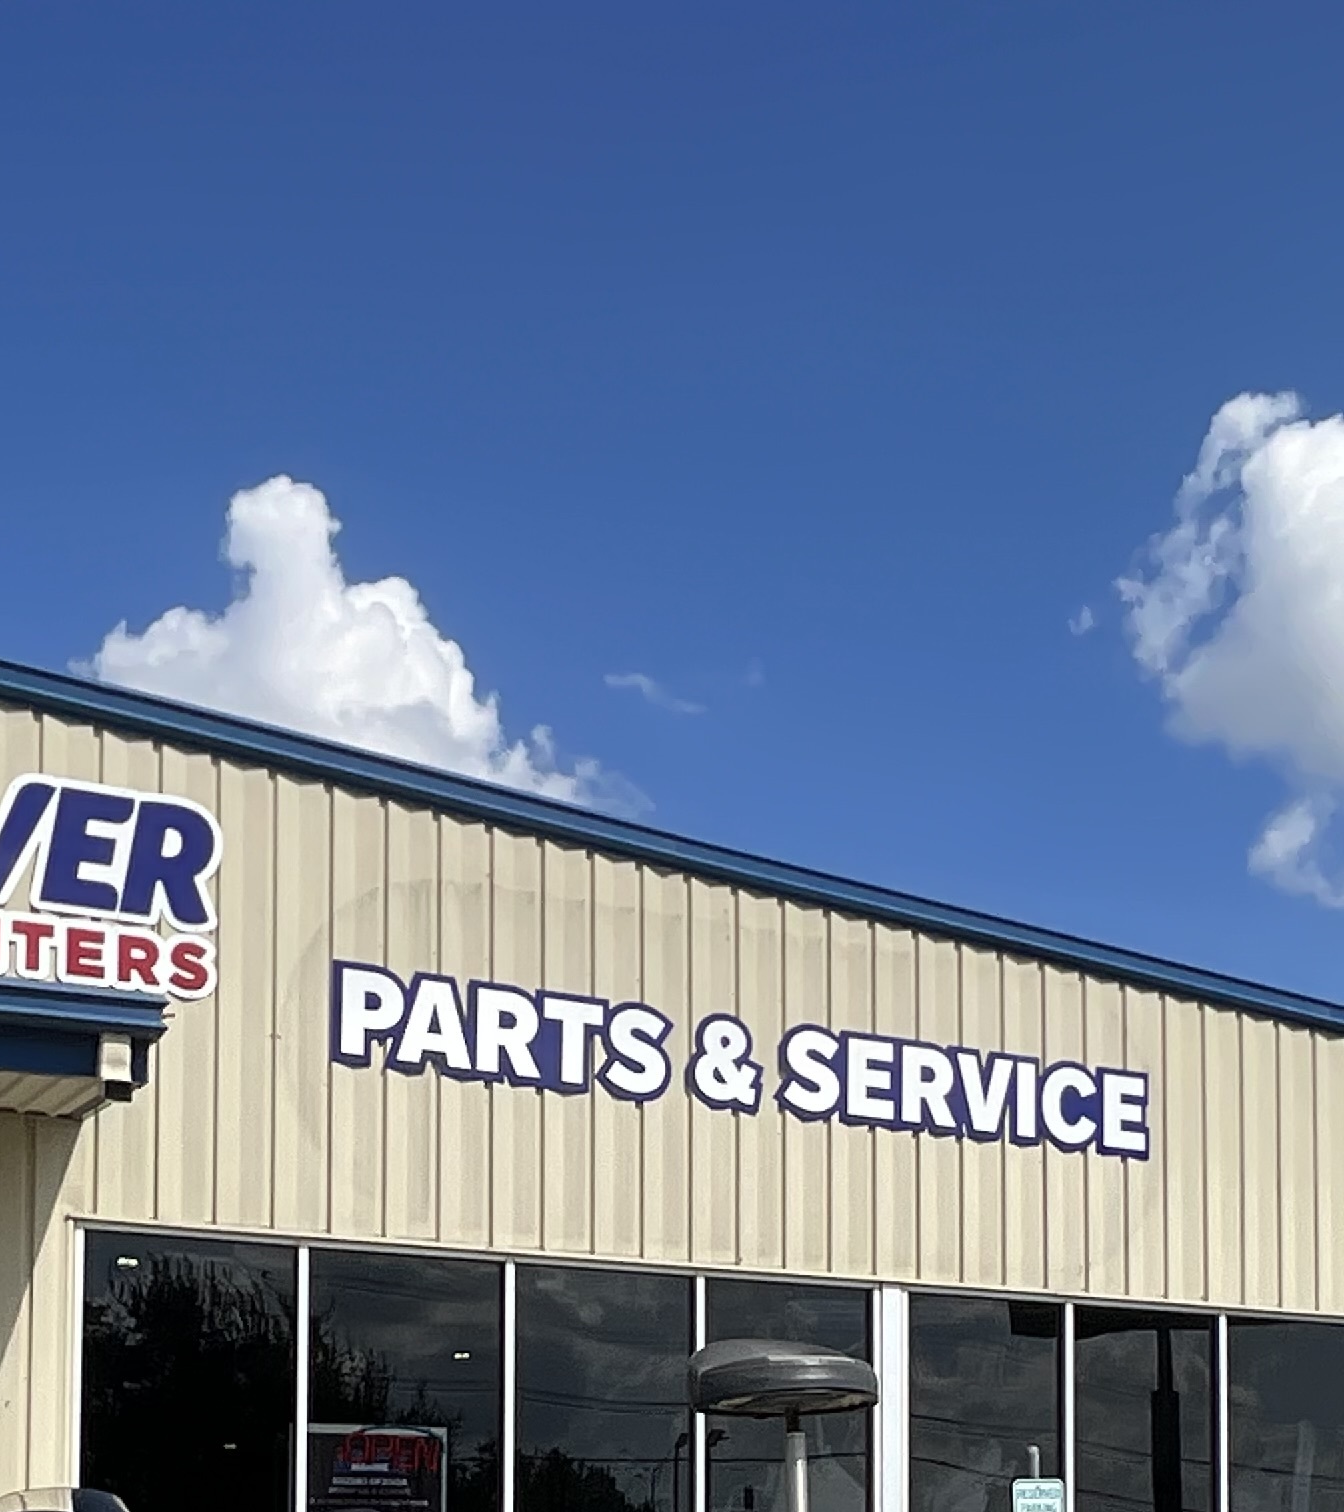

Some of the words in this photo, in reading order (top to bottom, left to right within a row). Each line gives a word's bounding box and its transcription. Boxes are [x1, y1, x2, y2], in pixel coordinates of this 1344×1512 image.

[338, 966, 670, 1097] PARTS
[692, 1019, 760, 1110] &
[783, 1029, 1149, 1154] SERVICE
